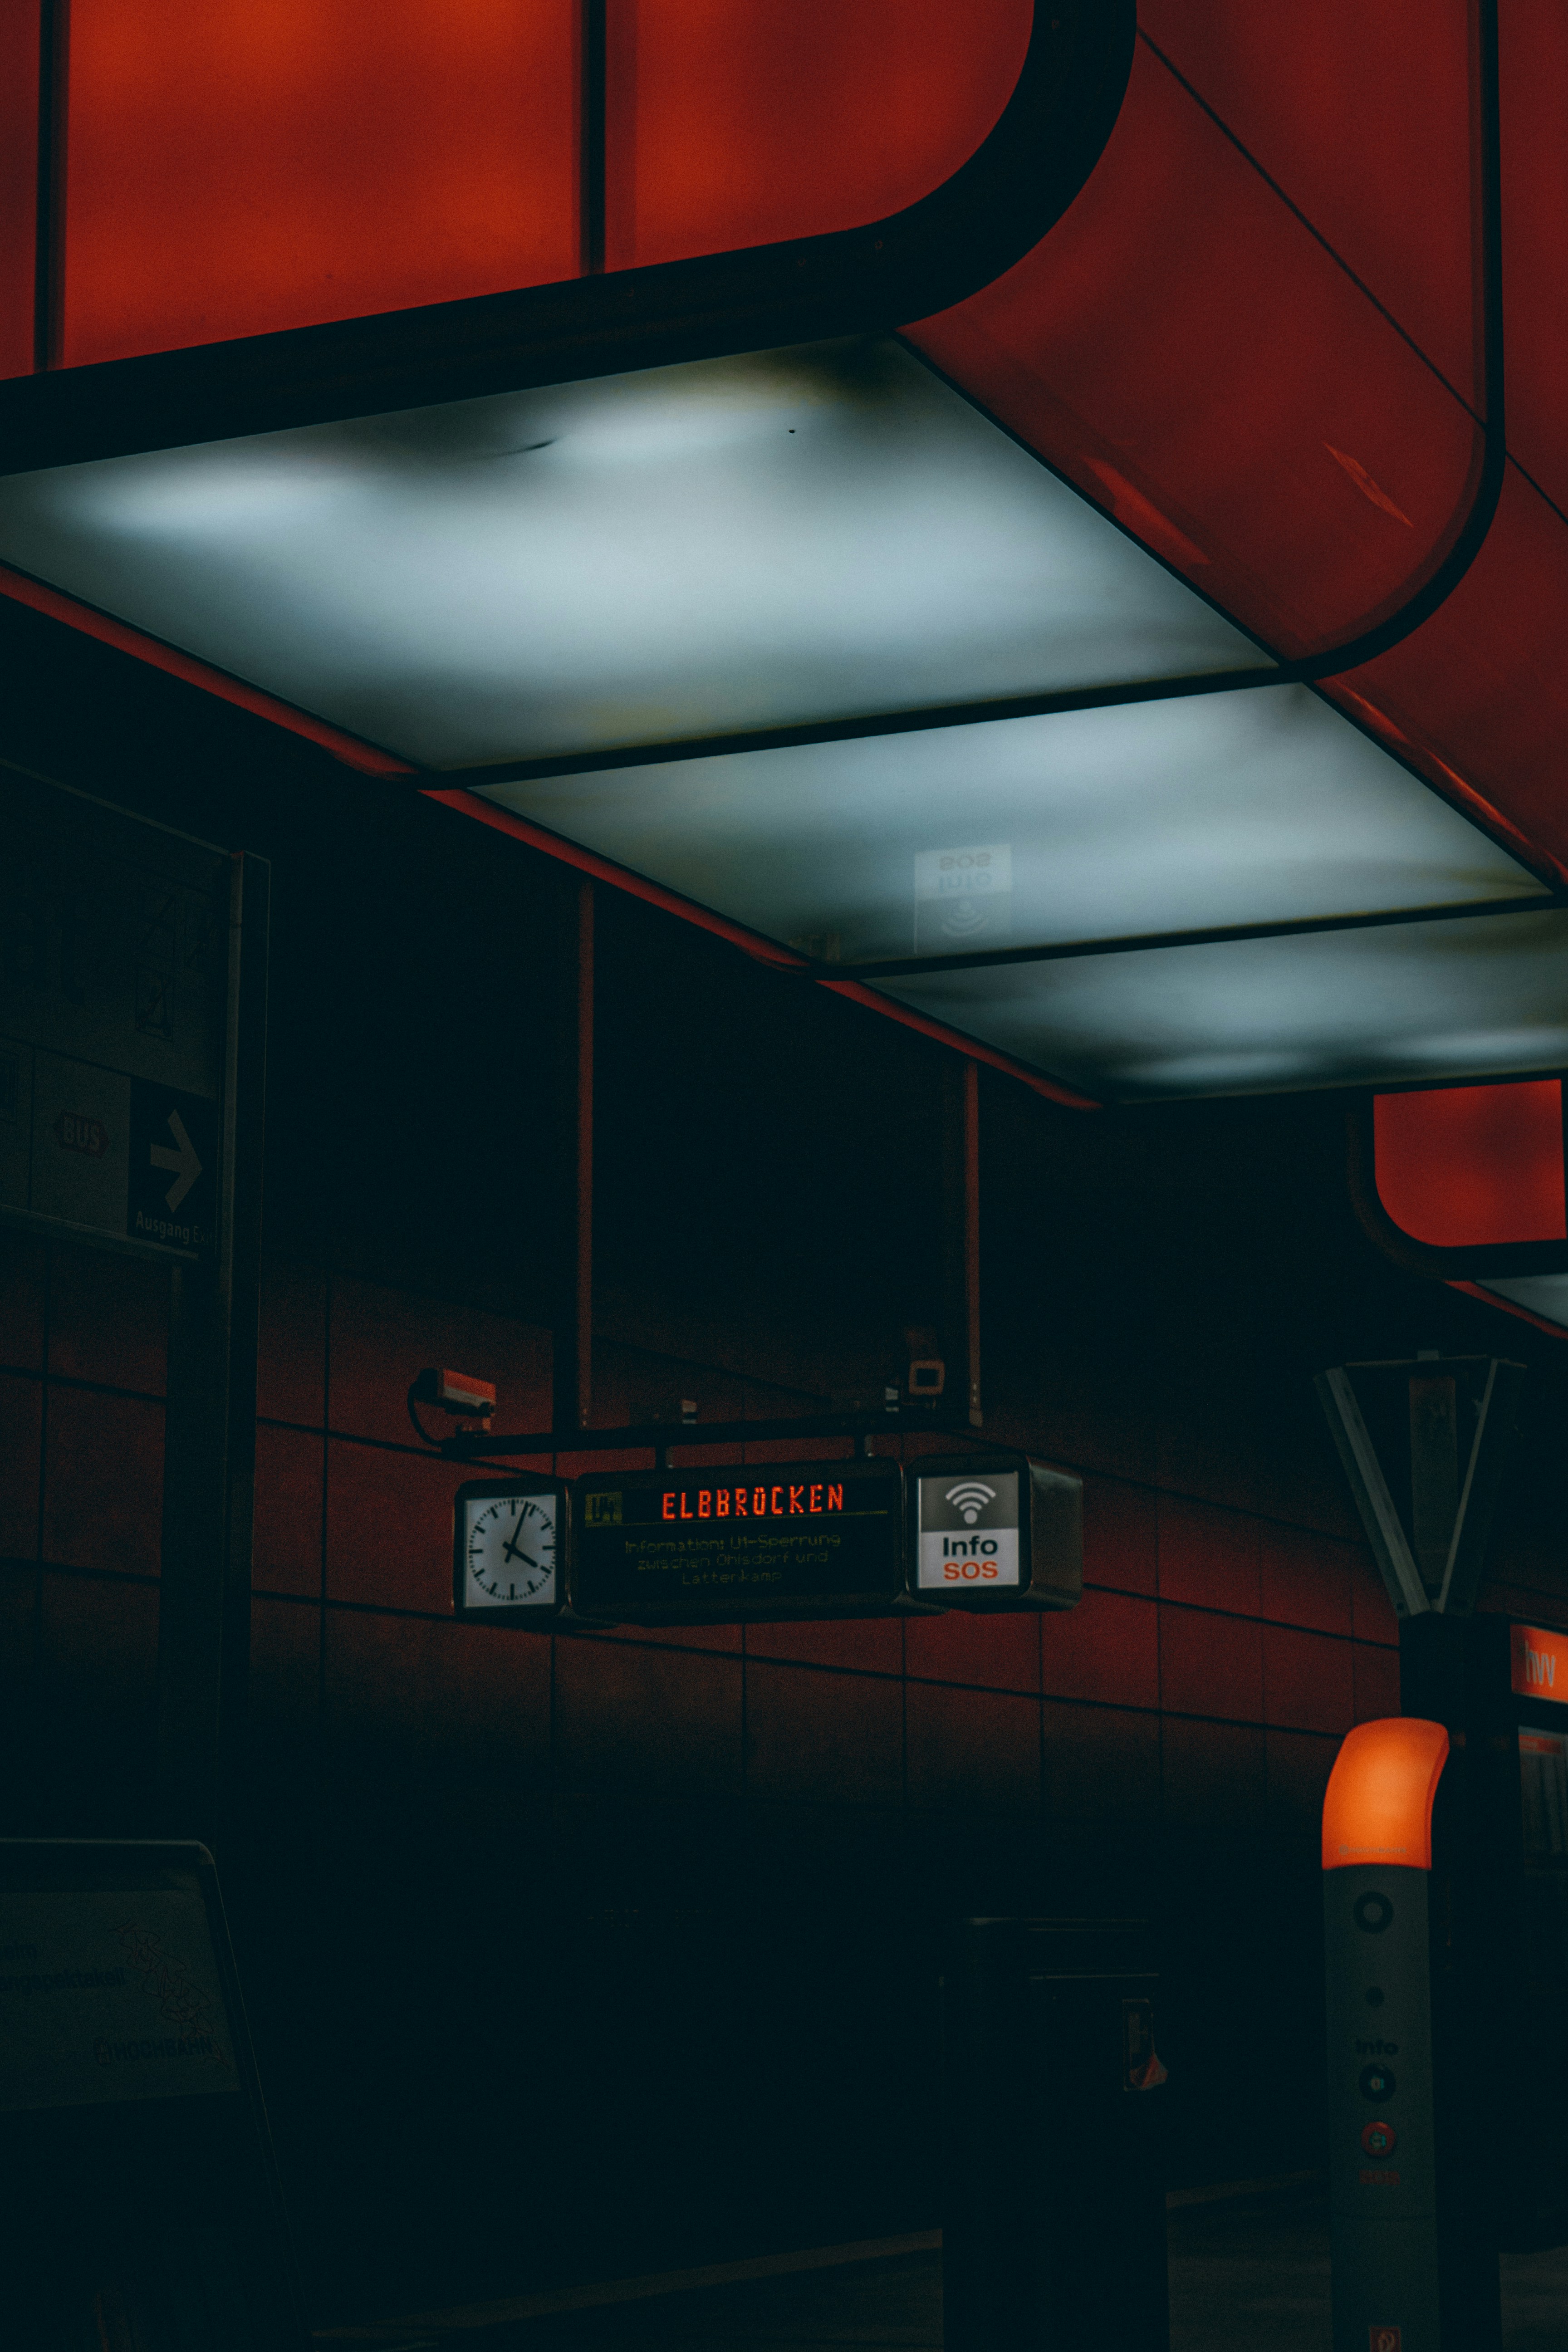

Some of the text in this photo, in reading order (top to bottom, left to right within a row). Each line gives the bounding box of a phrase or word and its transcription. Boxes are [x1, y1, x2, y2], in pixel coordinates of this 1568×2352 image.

[64, 1115, 101, 1152] BUS
[136, 1210, 190, 1245] Ausgang
[592, 1483, 843, 1522] U4 ELBBRÜCKEN
[624, 1534, 841, 1554] Information: U1-Sperrung
[943, 1535, 998, 1556] Info
[637, 1550, 828, 1570] zwischen Ohlsdorf und
[944, 1561, 998, 1579] SOS
[681, 1569, 783, 1585] Lattenkamp
[113, 2036, 212, 2061] HOCHBAHN
[1355, 2039, 1399, 2055] Info
